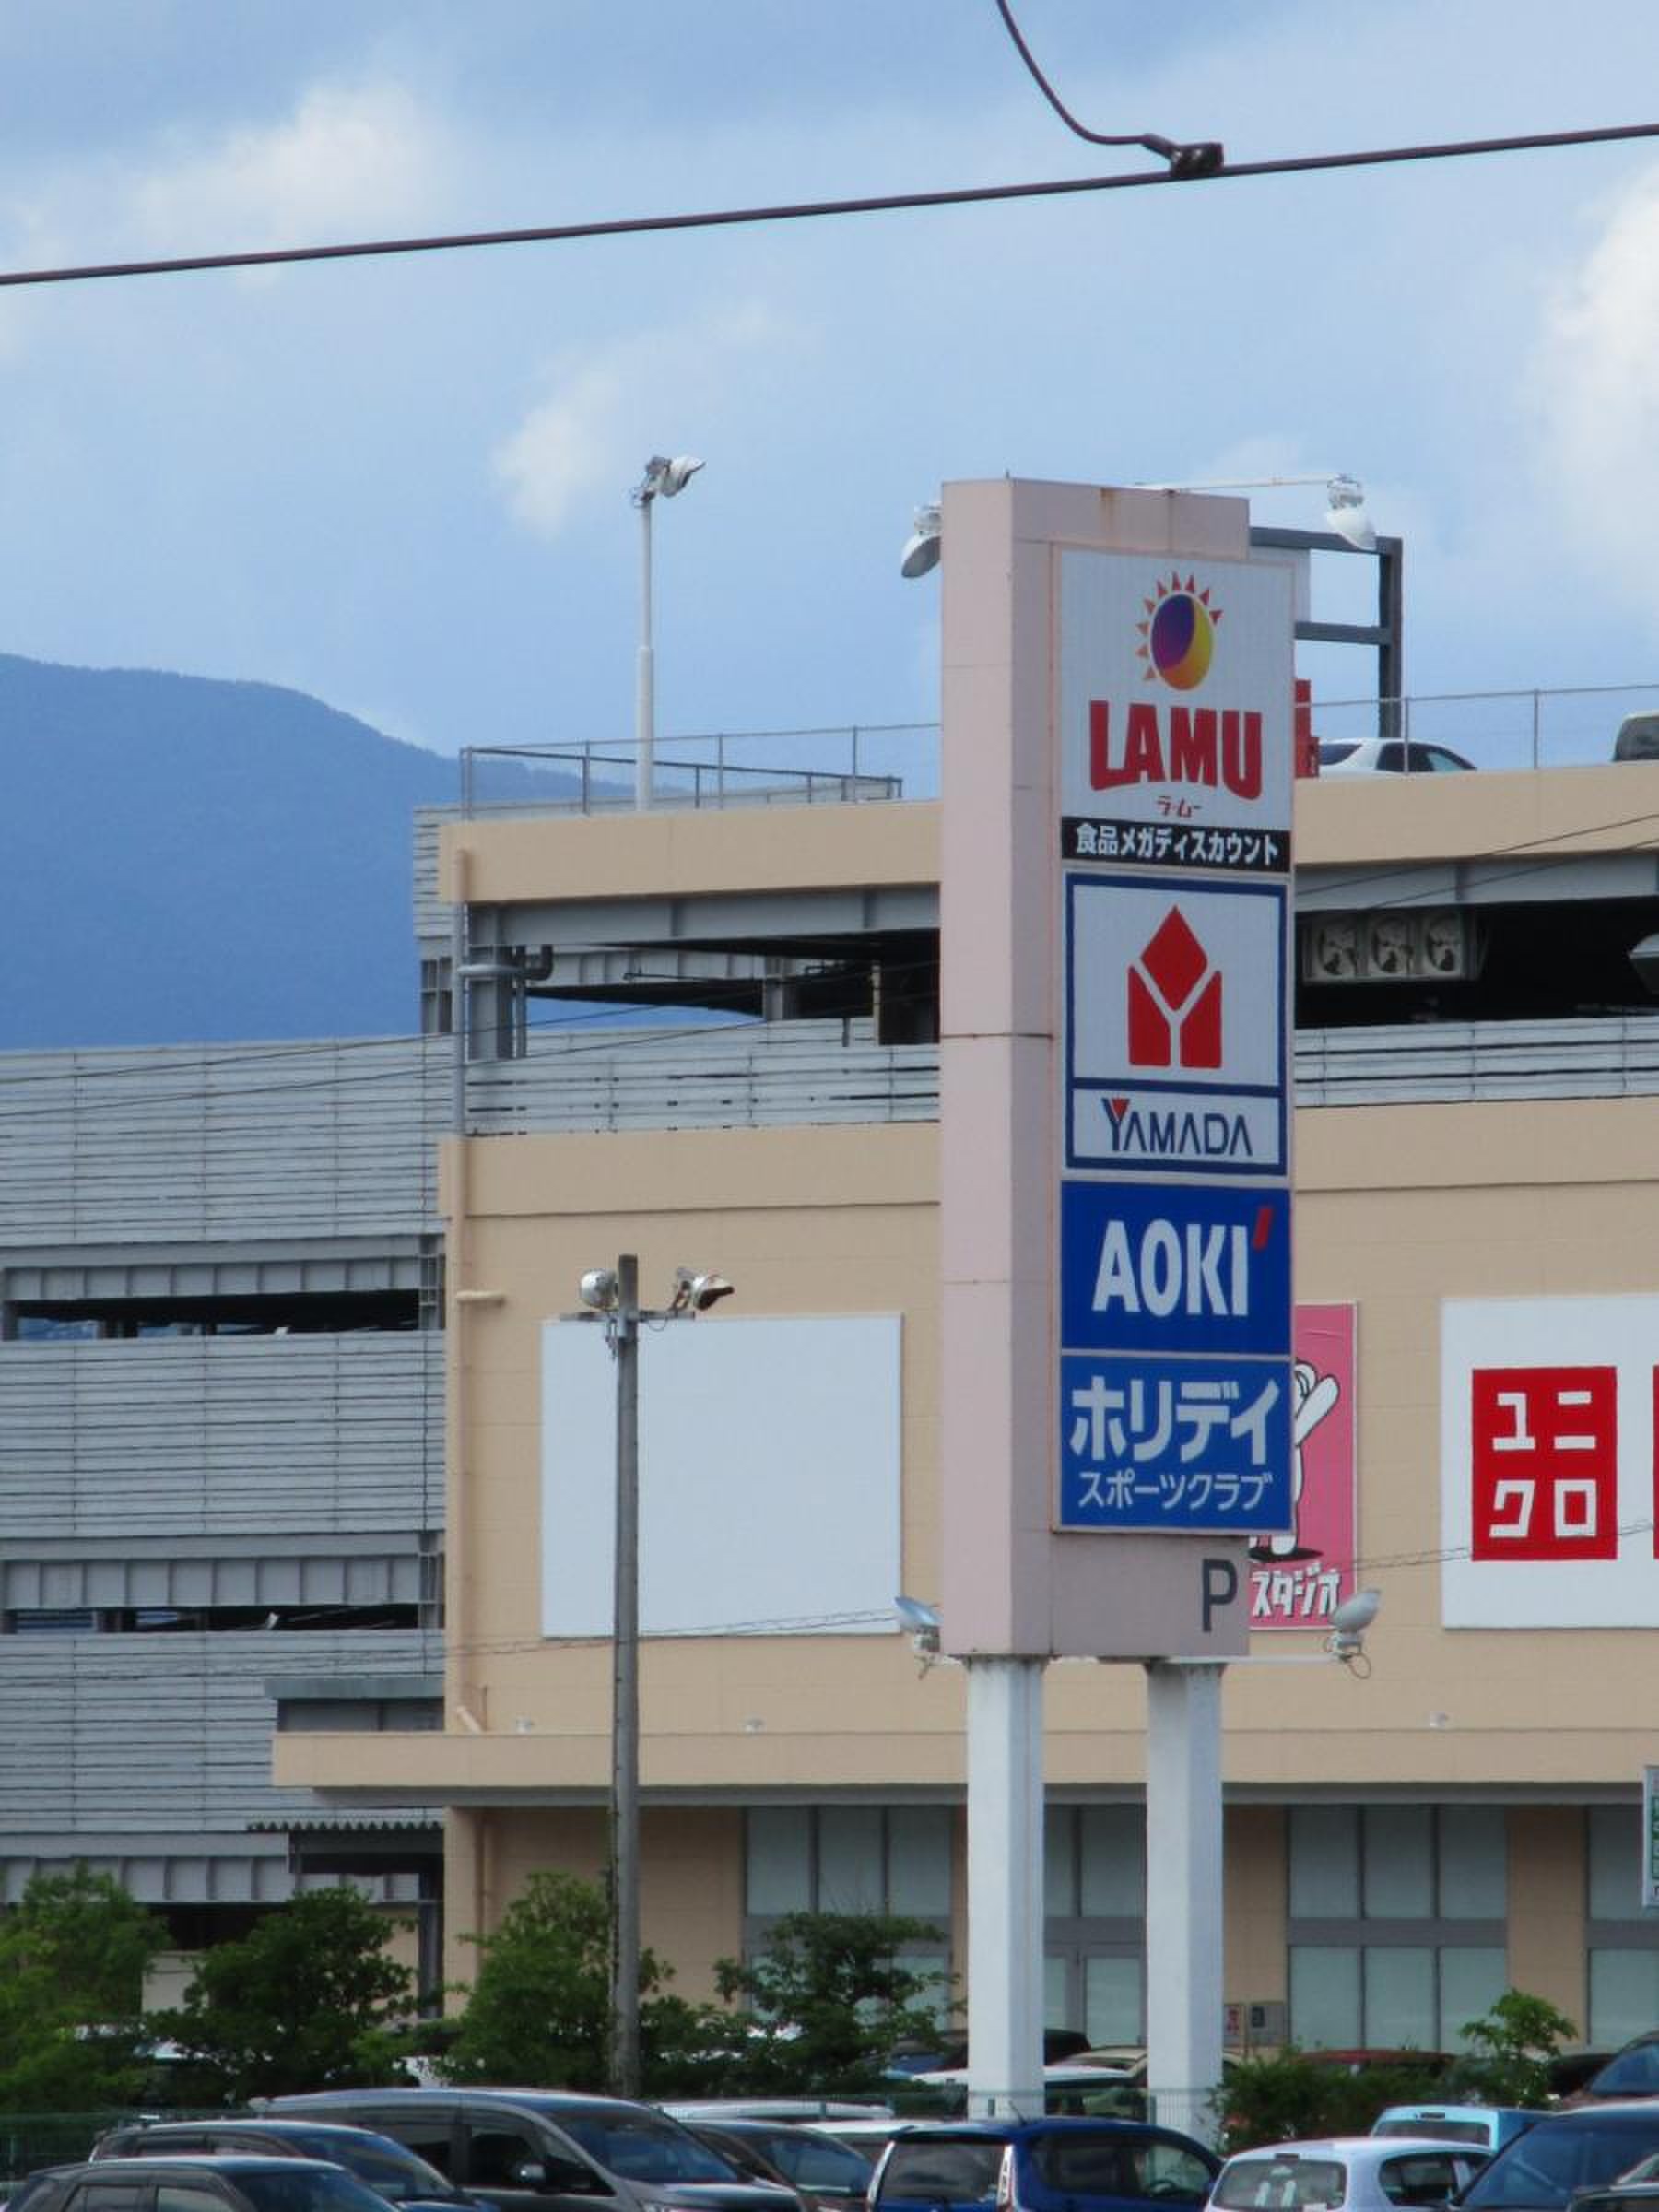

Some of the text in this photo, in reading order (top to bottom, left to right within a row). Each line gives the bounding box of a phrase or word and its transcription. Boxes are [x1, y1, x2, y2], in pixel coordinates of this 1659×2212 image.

[1089, 700, 1262, 801] LAMU
[1076, 822, 1278, 865] 食品メガディスカウント
[1101, 1097, 1253, 1156] YAMADA
[1070, 1375, 1280, 1465] ホリデイ
[1077, 1467, 1274, 1512] スポーツクラブ
[1202, 1558, 1238, 1633] P
[1251, 1561, 1341, 1618] スタジオ
